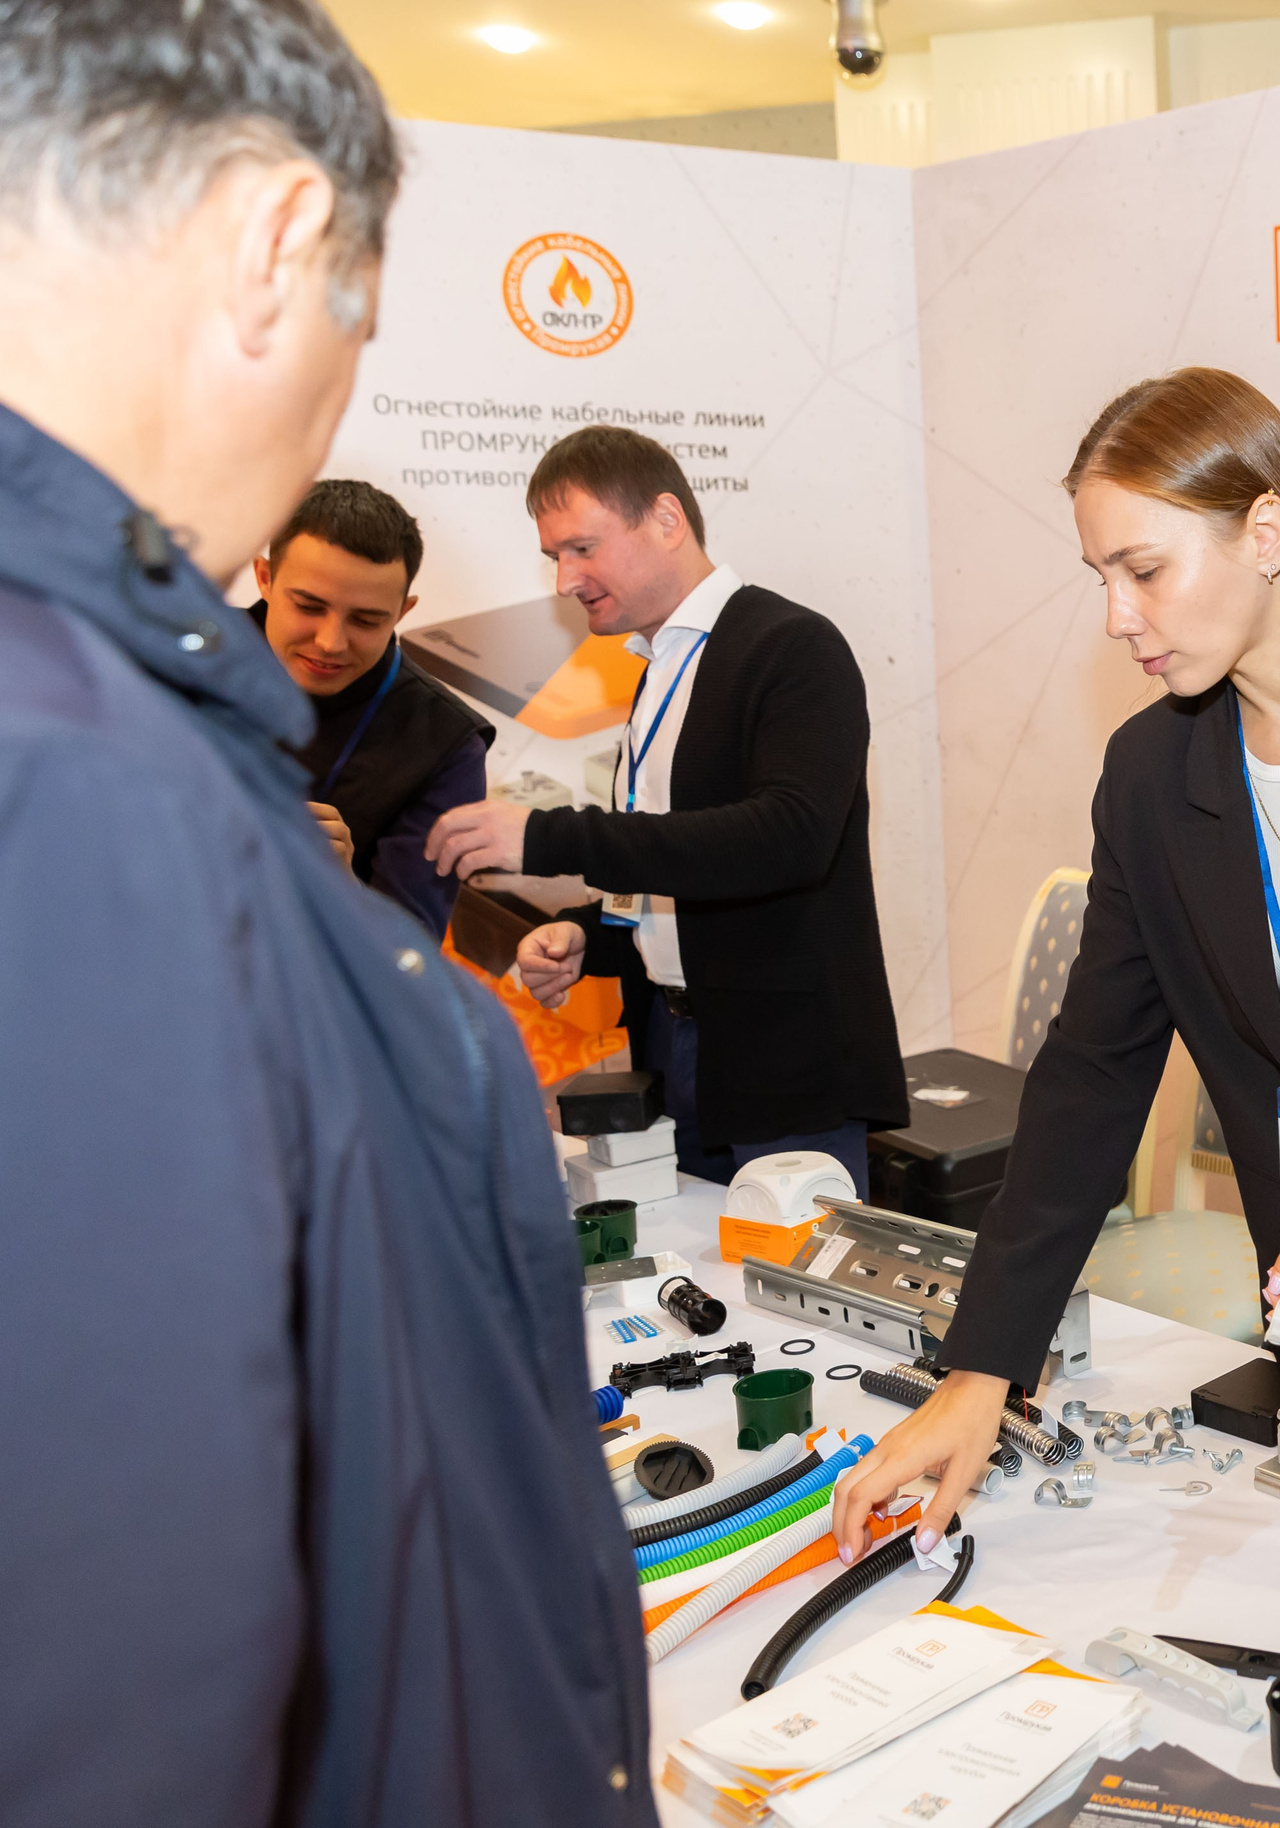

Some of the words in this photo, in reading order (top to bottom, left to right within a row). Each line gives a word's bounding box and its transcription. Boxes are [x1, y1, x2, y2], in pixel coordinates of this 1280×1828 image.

[373, 393, 542, 419] Огнестойкие
[552, 401, 686, 426] кабельные
[693, 411, 766, 428] линии
[421, 429, 556, 454] ПРОМРУК
[402, 468, 528, 488] противоп
[691, 476, 749, 492] щиты
[1089, 1793, 1158, 1812] КОРОБКА
